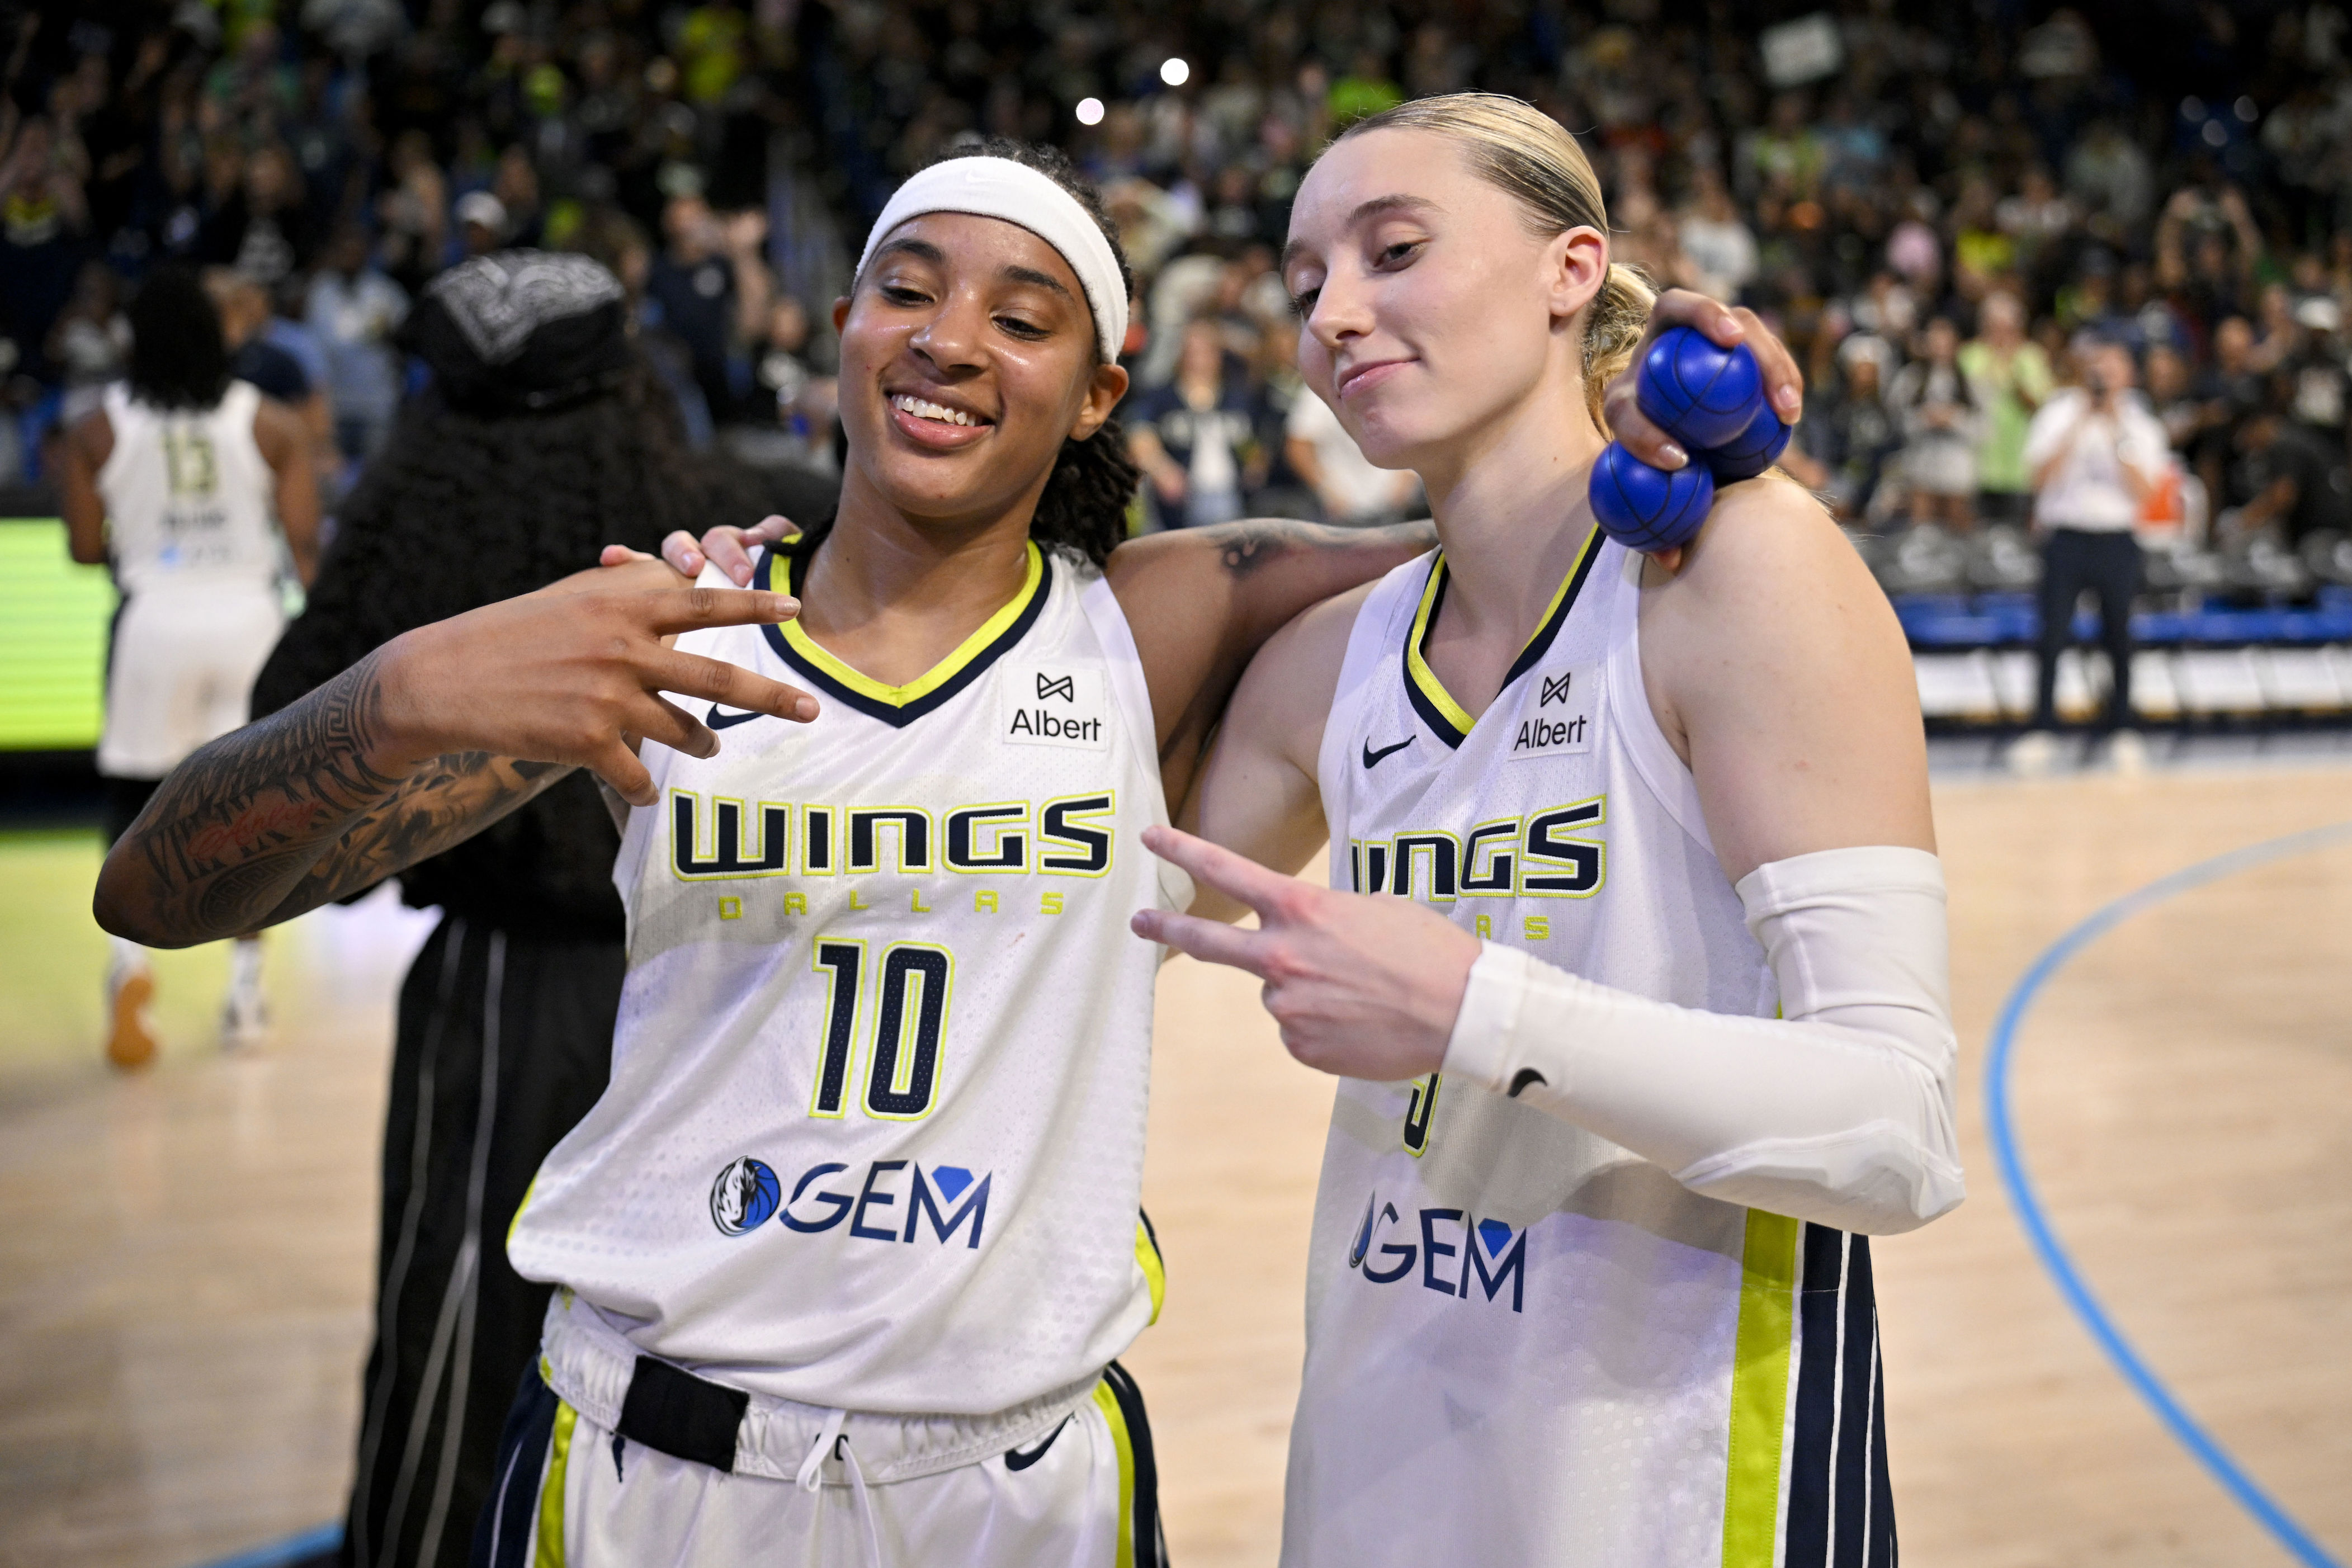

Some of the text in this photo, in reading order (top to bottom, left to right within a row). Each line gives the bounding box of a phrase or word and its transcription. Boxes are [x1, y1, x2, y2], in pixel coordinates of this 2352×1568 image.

[1010, 709, 1102, 742] Albert
[1513, 715, 1587, 752] Albert
[670, 787, 1115, 881] WINGS
[1349, 793, 1607, 903] INGS
[719, 890, 1064, 920] DALLAS
[808, 936, 955, 1122] 10
[778, 1159, 993, 1250] GEM
[1362, 1201, 1527, 1314] GEM
